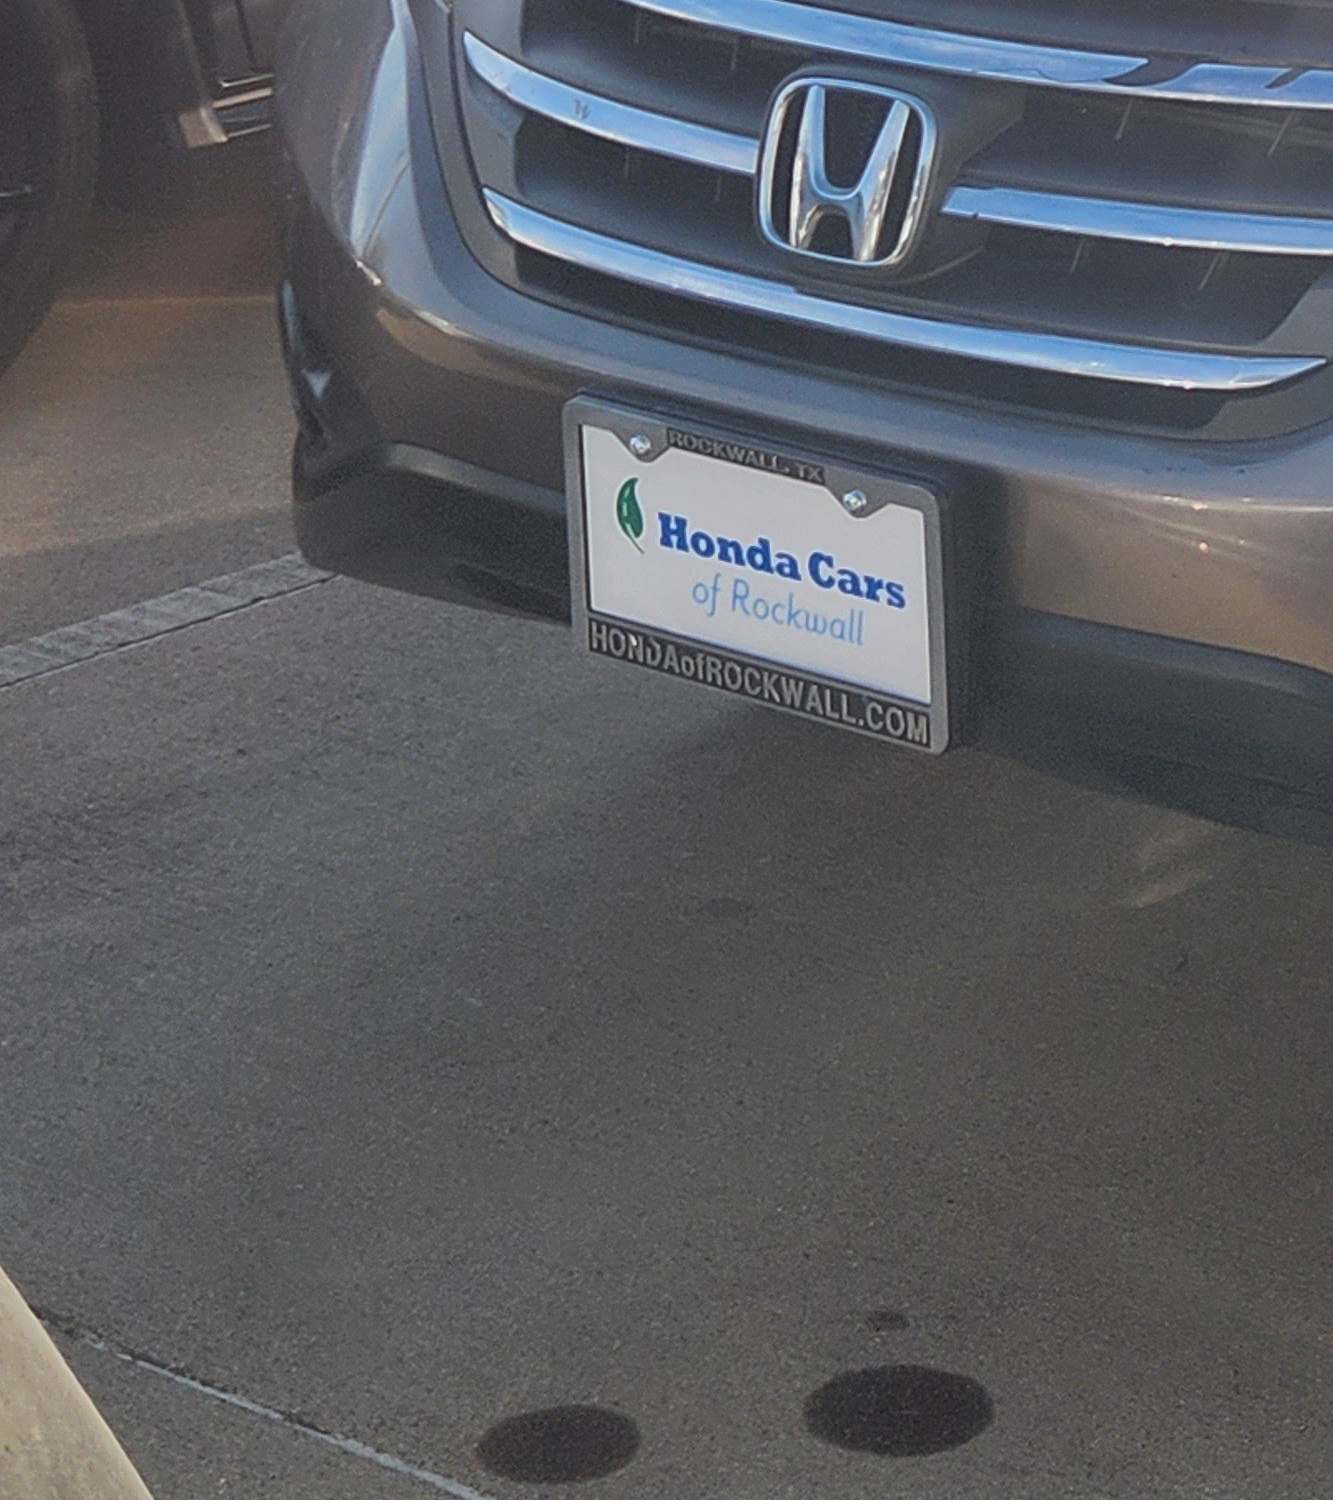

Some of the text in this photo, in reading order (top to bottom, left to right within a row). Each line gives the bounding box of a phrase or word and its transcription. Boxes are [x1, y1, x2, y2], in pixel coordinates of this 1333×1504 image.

[798, 464, 823, 482] TX
[658, 512, 906, 609] Honda Cars
[691, 573, 865, 645] of Rockwall
[591, 620, 928, 744] HONDAofROCKWALL.COM
